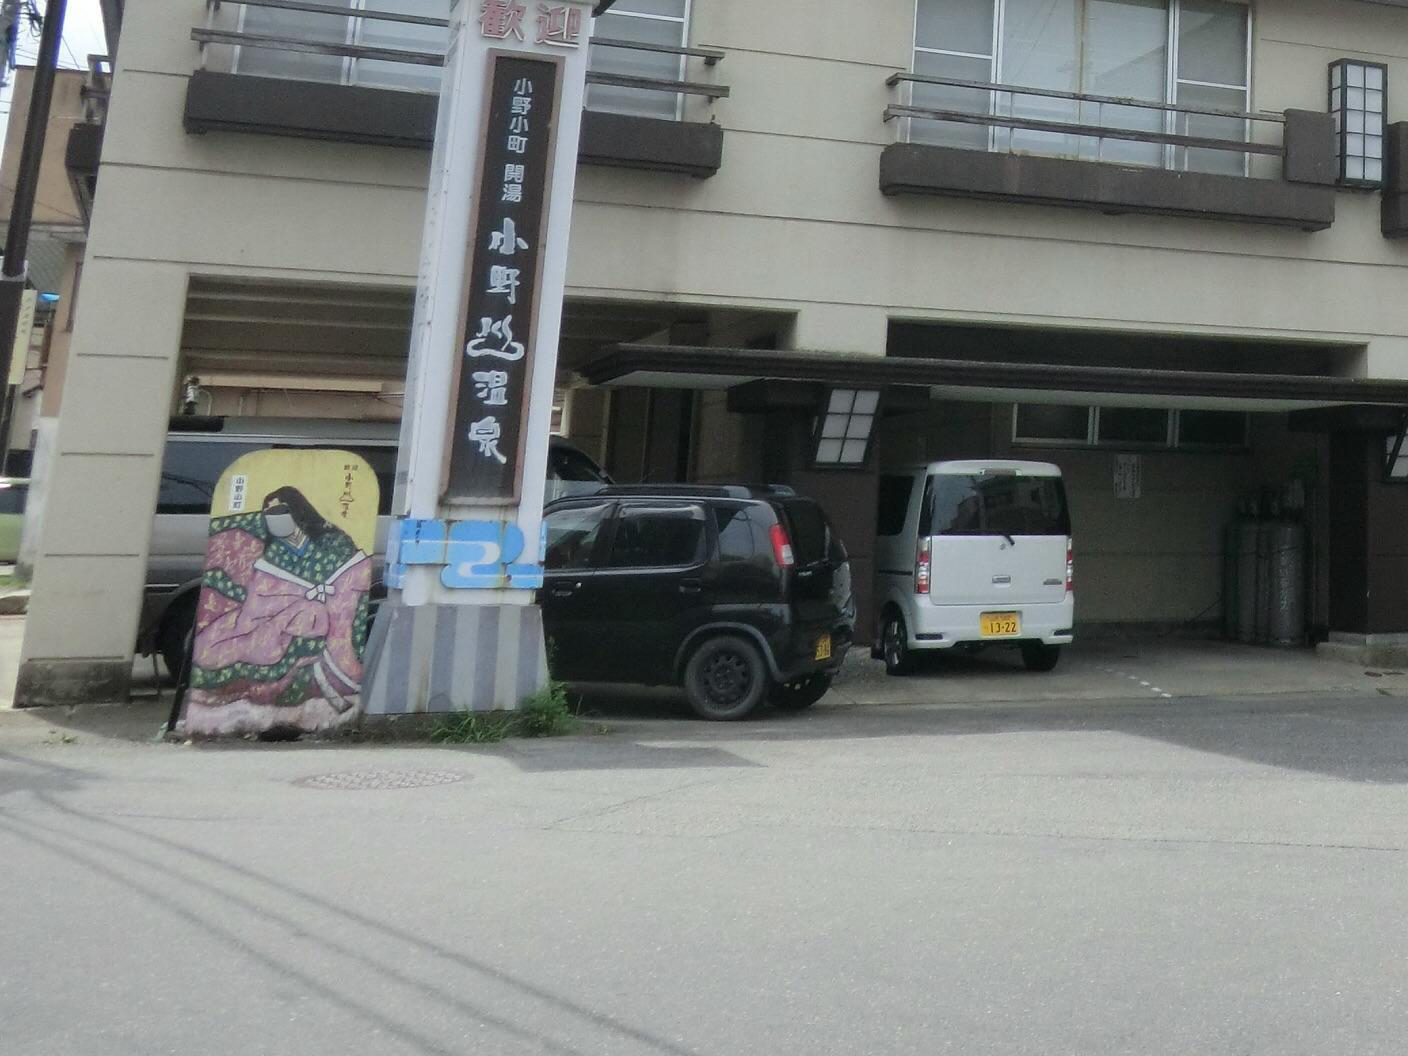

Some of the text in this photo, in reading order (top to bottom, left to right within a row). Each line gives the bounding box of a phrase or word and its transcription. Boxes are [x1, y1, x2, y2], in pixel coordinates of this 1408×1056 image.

[501, 77, 533, 203] 小野小町 開湯
[466, 217, 529, 465] 小野川温泉
